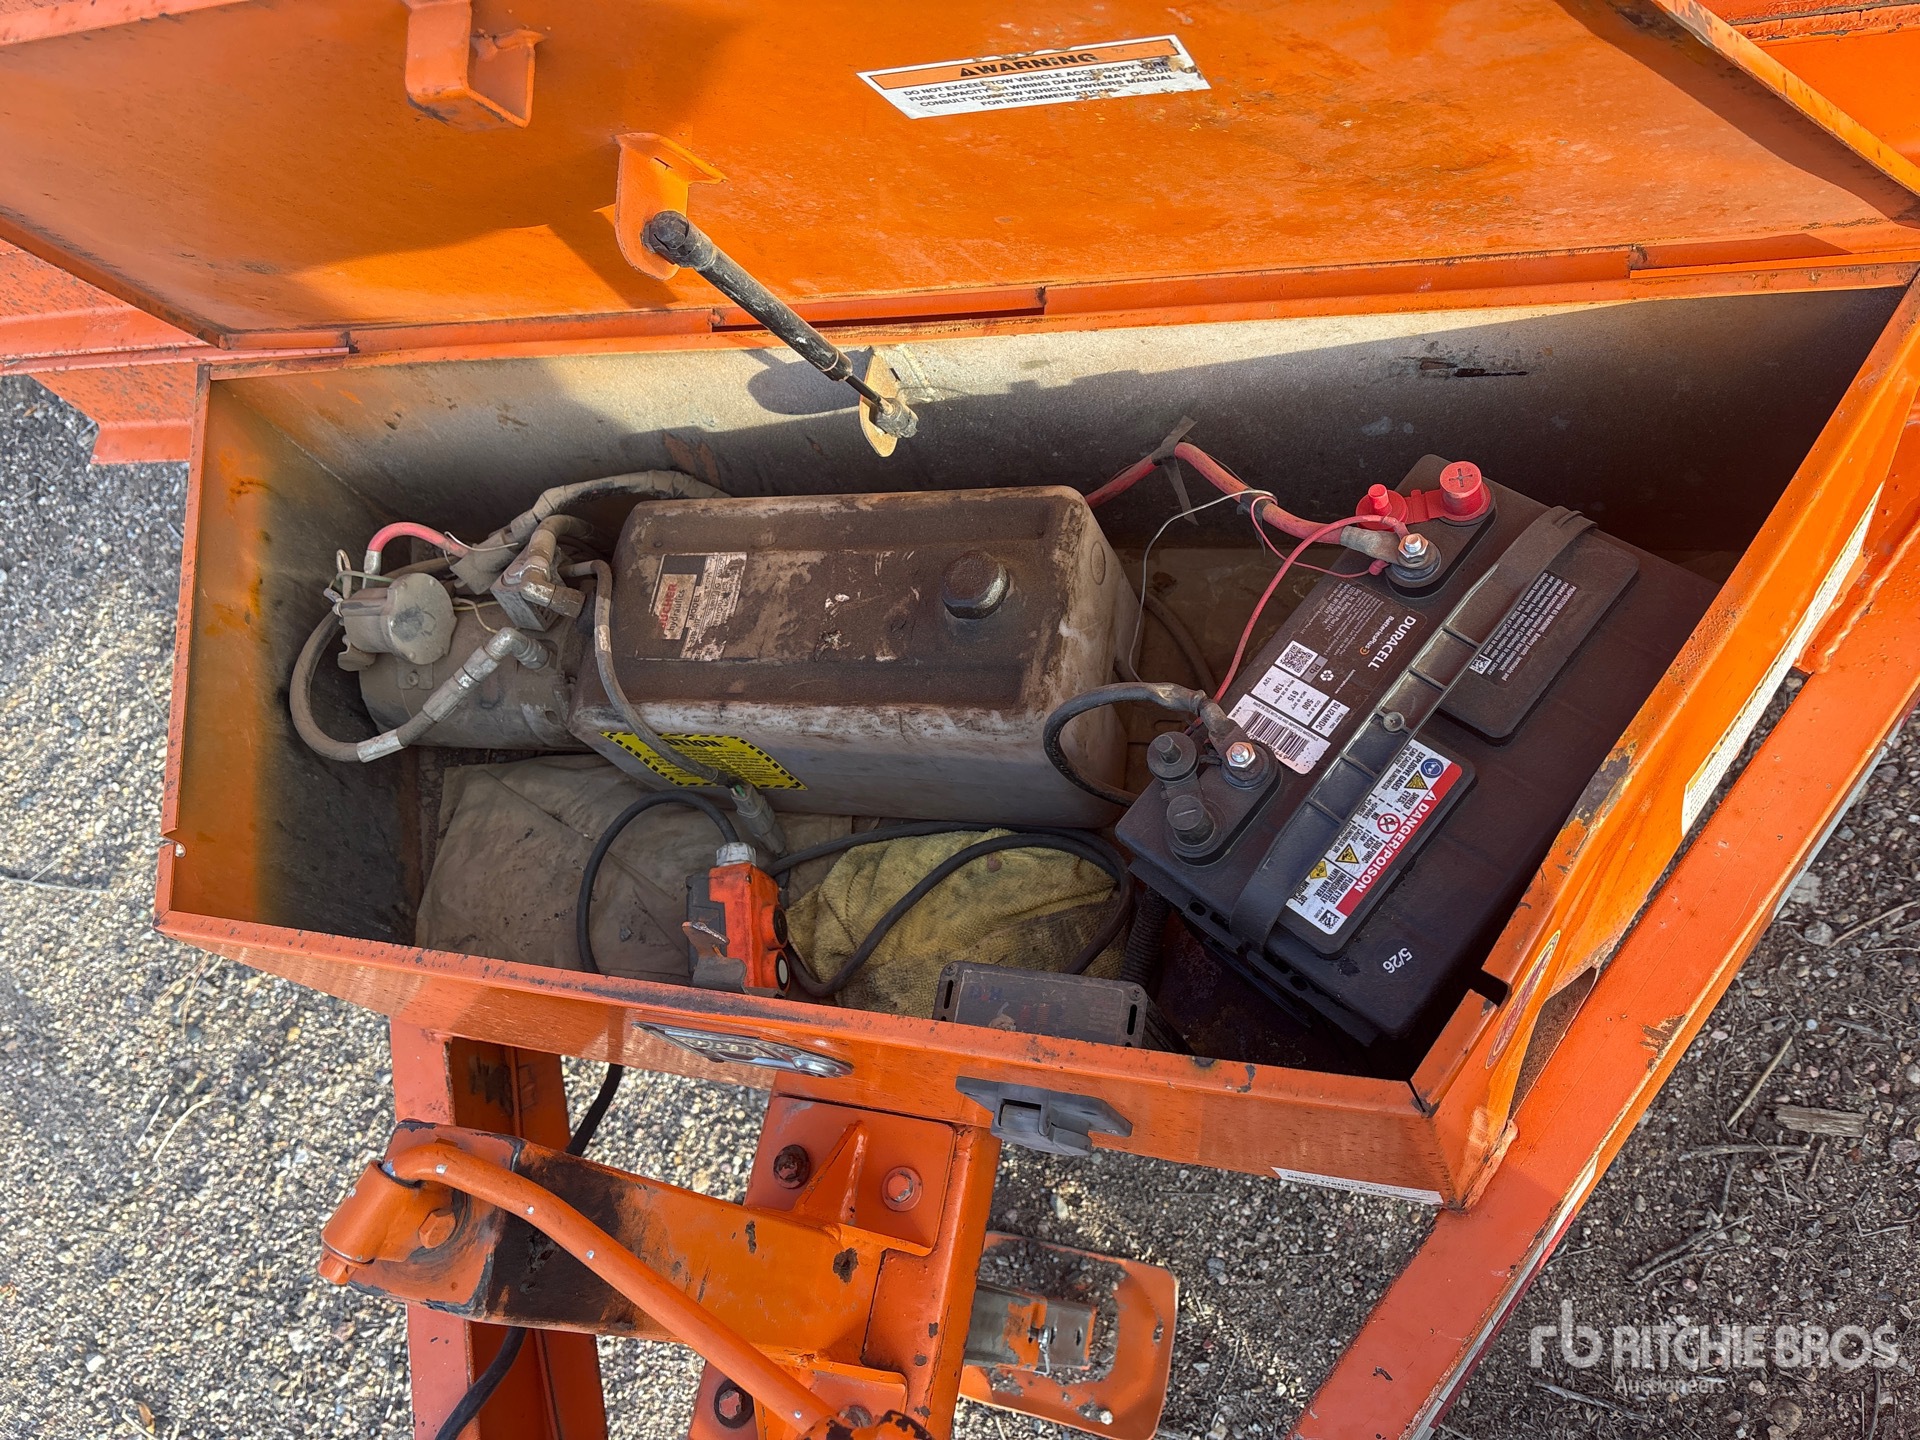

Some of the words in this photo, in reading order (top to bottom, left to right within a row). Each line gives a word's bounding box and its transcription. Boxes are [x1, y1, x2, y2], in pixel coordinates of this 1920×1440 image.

[972, 52, 1099, 75] WARNING
[1014, 72, 1065, 83] VEHICLE
[1137, 60, 1170, 69] WRE
[907, 93, 938, 101] FUSE
[936, 87, 991, 98] CAPACITY
[1008, 80, 1052, 90] WIRING
[1102, 72, 1128, 80] MAY
[1129, 67, 1174, 77] OCCUR
[918, 97, 969, 106] CONSULT
[968, 93, 1000, 101] YOU
[1024, 85, 1073, 95] VEHICLE
[1073, 79, 1125, 90] OWNERS
[1125, 74, 1176, 84] MANUAL
[657, 584, 677, 628] UCHER
[667, 589, 685, 630] hydraulics
[688, 592, 701, 620] MODEL
[1366, 615, 1417, 670] DURACELL
[1308, 662, 1321, 675] Pb
[1261, 676, 1271, 686] 12V
[1272, 682, 1284, 693] 130
[1286, 689, 1299, 702] 615
[1301, 698, 1313, 710] 500
[1314, 701, 1341, 730] SLI24MDC
[1334, 712, 1343, 722] PART
[1397, 754, 1411, 770] CAUSE
[1402, 750, 1426, 777] EXPLOSIVE
[1380, 767, 1401, 791] BLINDNESS
[1390, 774, 1407, 792] GASES
[1402, 791, 1420, 810] SHIELD
[1370, 811, 1380, 820] NO
[1349, 827, 1363, 842] CAUSE
[1358, 831, 1369, 842] CAN
[1362, 835, 1376, 849] ACID
[1353, 801, 1429, 893] DANGER/POISON
[1360, 839, 1382, 864] SULFURIC
[1326, 867, 1340, 882] WITH
[1337, 875, 1353, 893] FLUSH
[1289, 879, 1310, 902] MEDICAL
[1318, 871, 1347, 904] IMMEDIATELY
[1296, 894, 1308, 906] GET
[1328, 890, 1342, 905] EYES
[1381, 946, 1414, 975] 5/26
